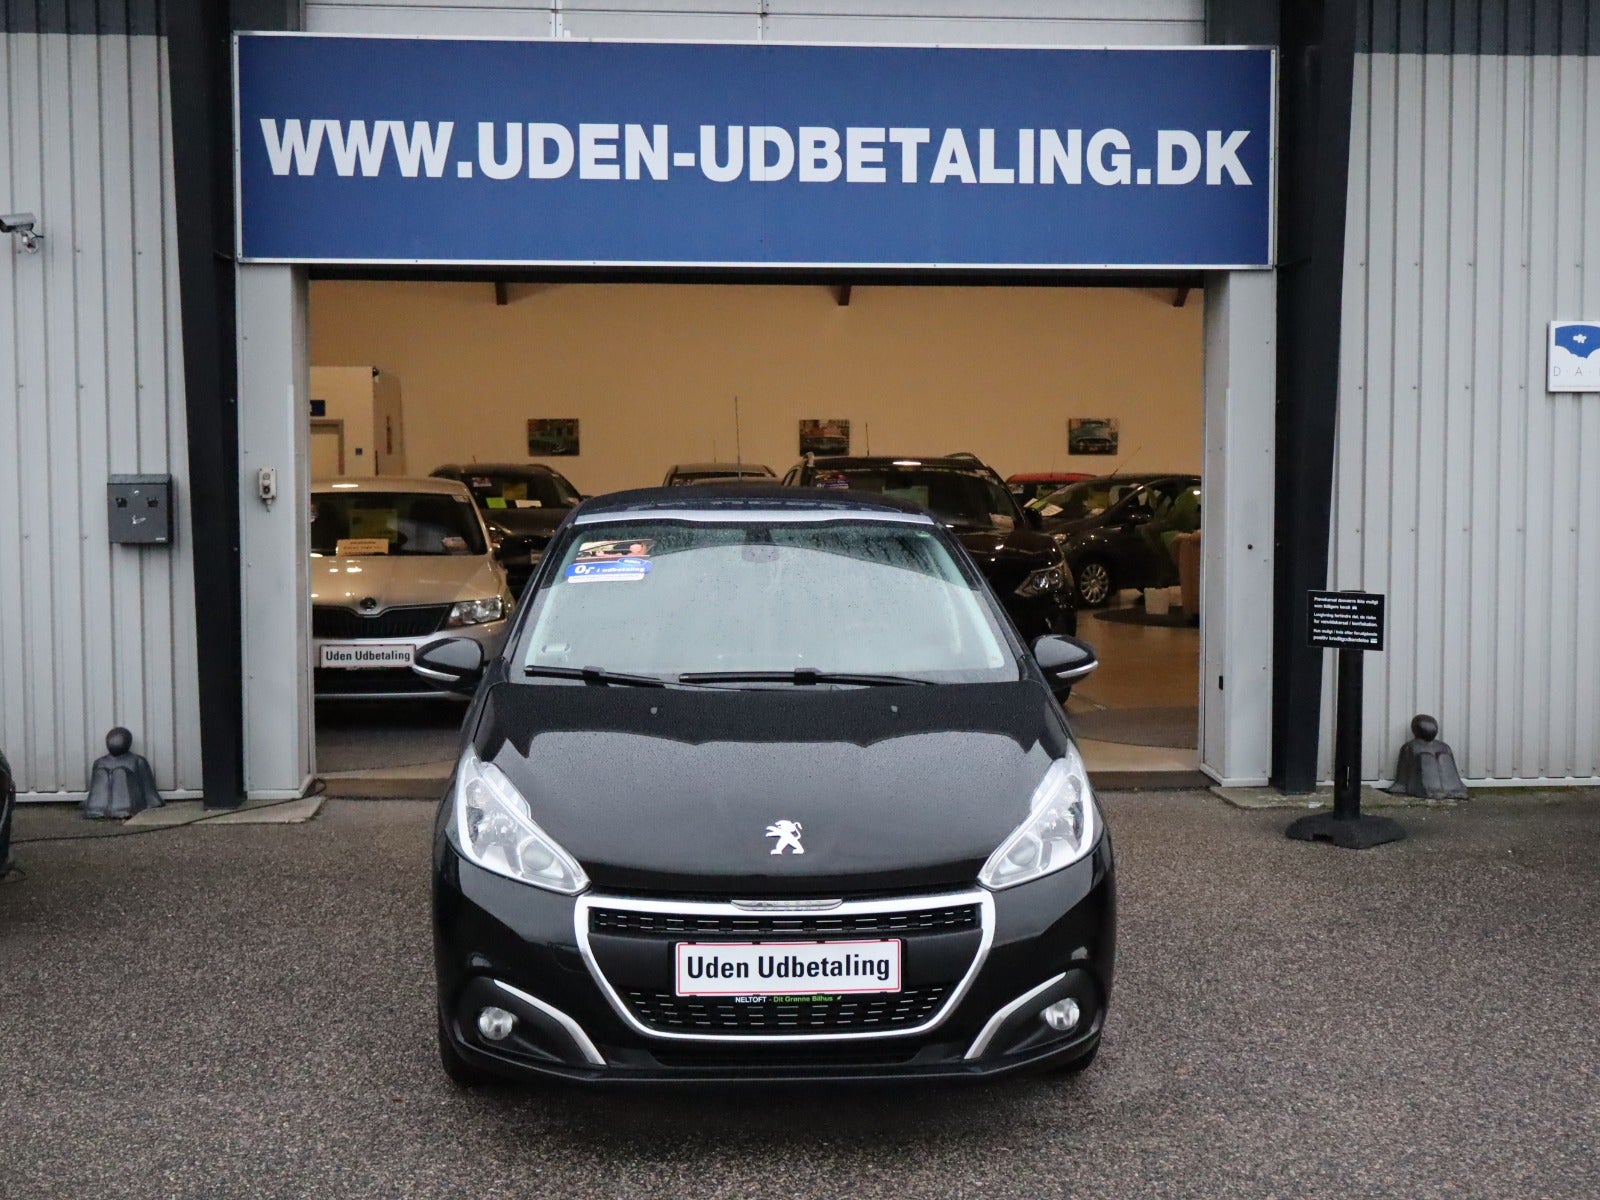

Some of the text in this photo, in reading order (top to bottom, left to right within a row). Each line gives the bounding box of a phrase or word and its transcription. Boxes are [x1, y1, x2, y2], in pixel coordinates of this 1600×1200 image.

[259, 118, 1253, 187] WWW.UDEN-UDBETALING.DK
[325, 650, 411, 662] Uden Udbetaling
[687, 954, 890, 981] Uden Udbetaling
